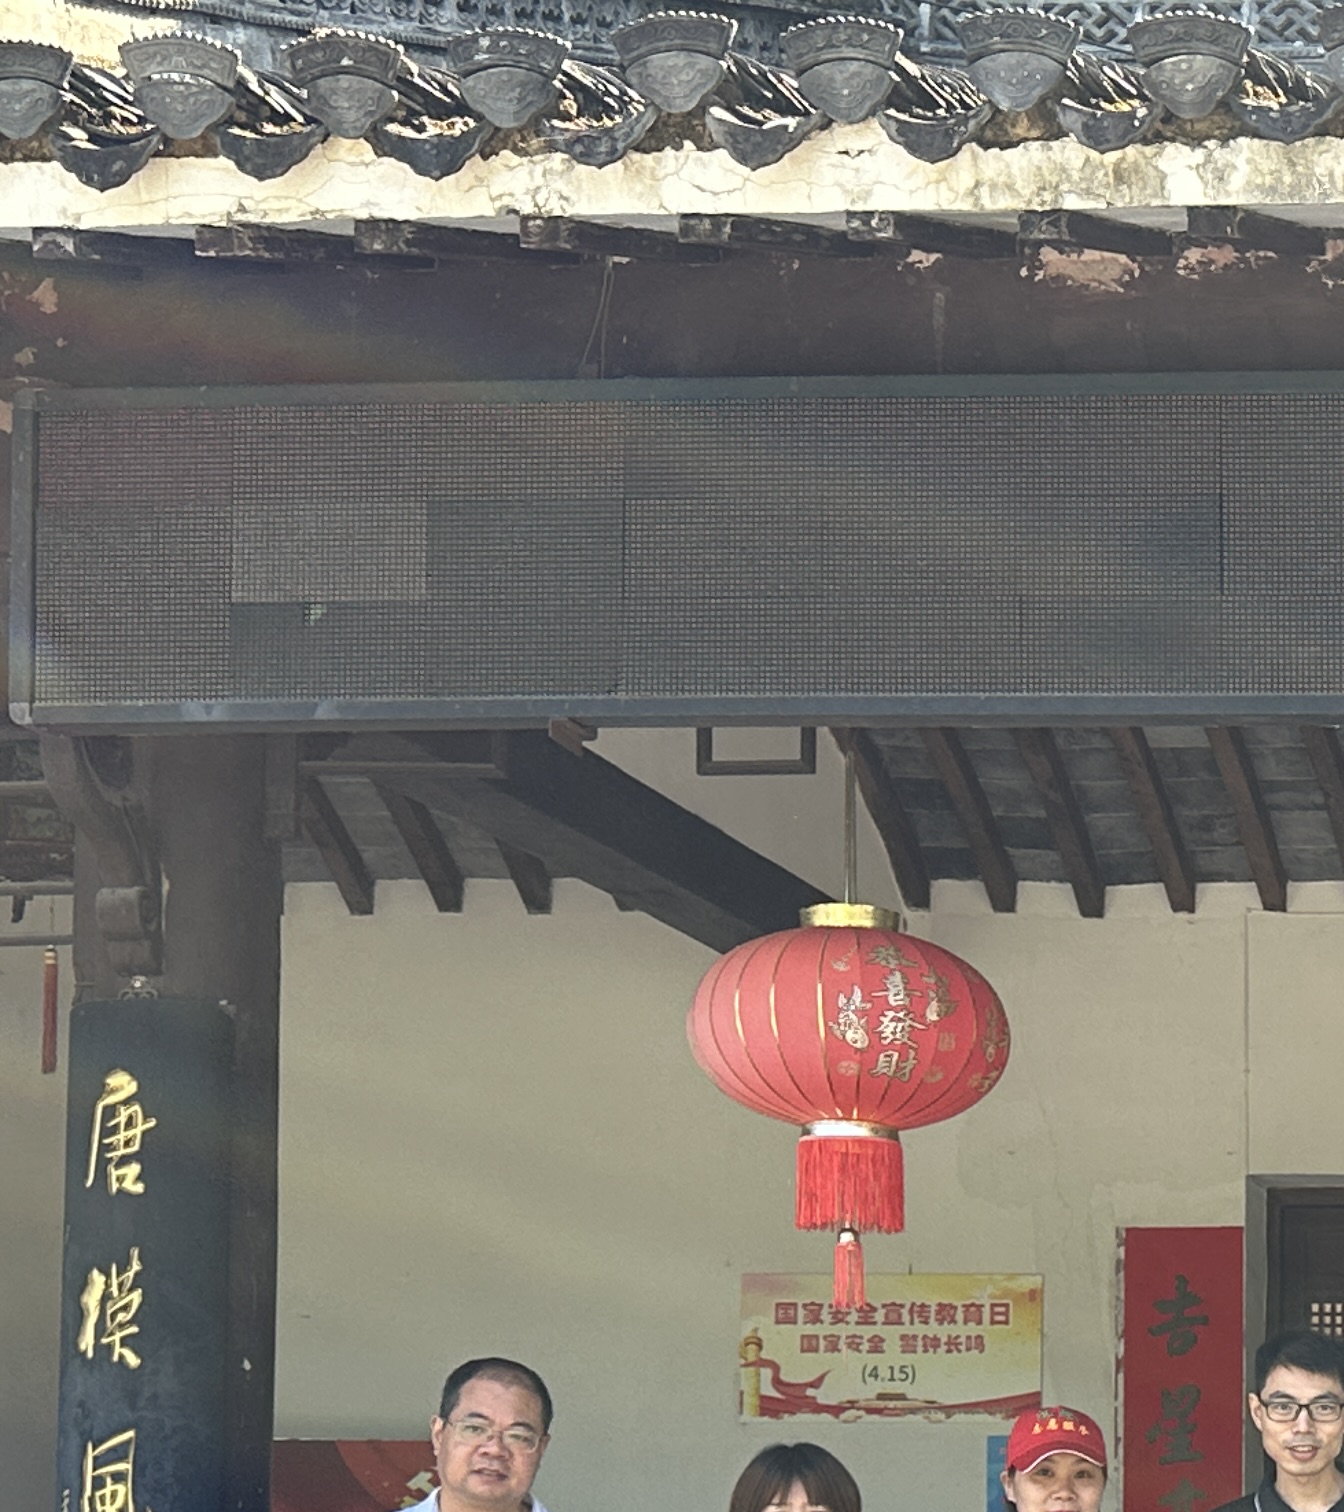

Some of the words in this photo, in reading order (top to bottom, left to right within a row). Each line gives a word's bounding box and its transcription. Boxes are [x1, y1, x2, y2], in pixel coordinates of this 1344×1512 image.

[865, 945, 929, 1082] 恭喜發財
[774, 1302, 1012, 1326] 国家安全宣传教育日
[800, 1334, 886, 1354] 国家安全
[899, 1334, 985, 1354] 警钟长鸣
[861, 1364, 916, 1385] (4.15)
